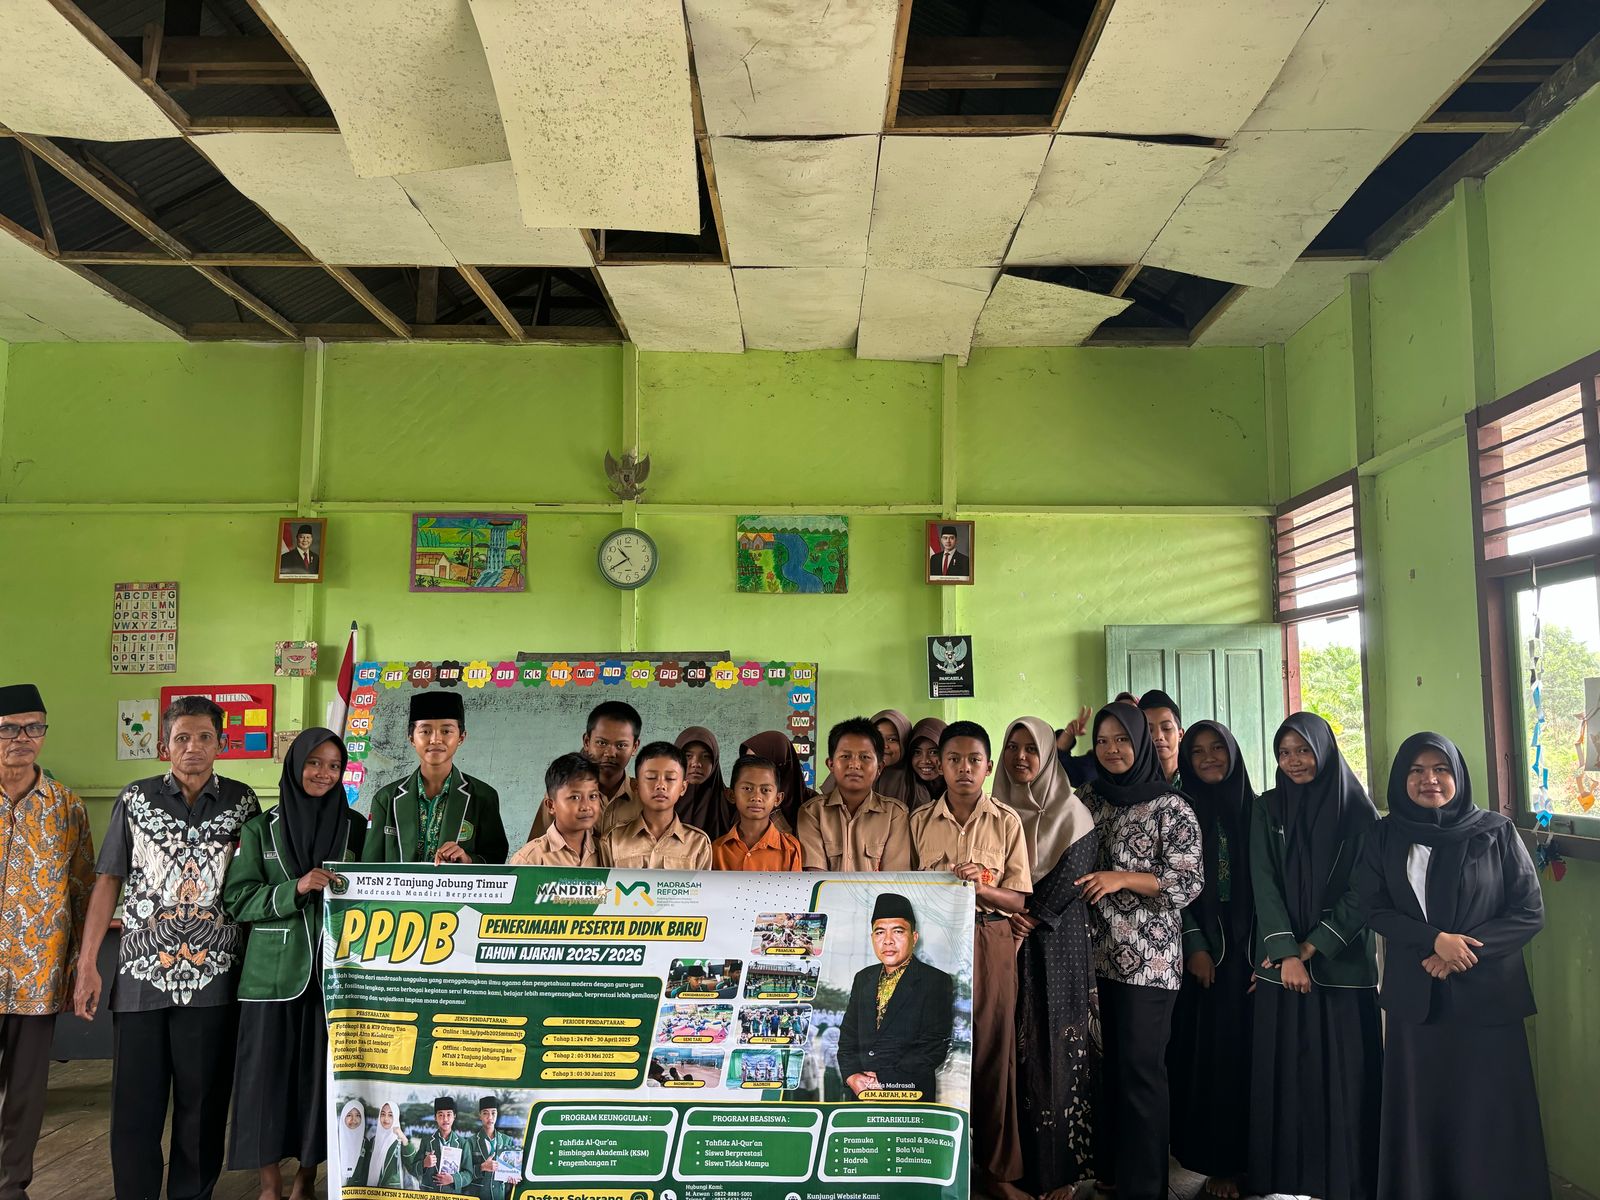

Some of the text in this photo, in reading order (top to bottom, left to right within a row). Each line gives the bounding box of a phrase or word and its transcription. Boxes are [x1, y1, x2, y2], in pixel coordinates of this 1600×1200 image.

[387, 672, 401, 680] Ff
[414, 670, 430, 678] Gg
[441, 670, 458, 678] Hh
[689, 670, 704, 678] Qq
[356, 876, 508, 890] MTsN 2 Tanjung Jabung Timur
[537, 886, 597, 895] MANDIRI
[485, 918, 702, 937] PENERIMAAN PESERTA DIDIK BARU
[334, 908, 459, 965] PPDB
[479, 945, 643, 962] TAHUN AJARAN 2025/2026
[940, 1139, 954, 1148] Kaki
